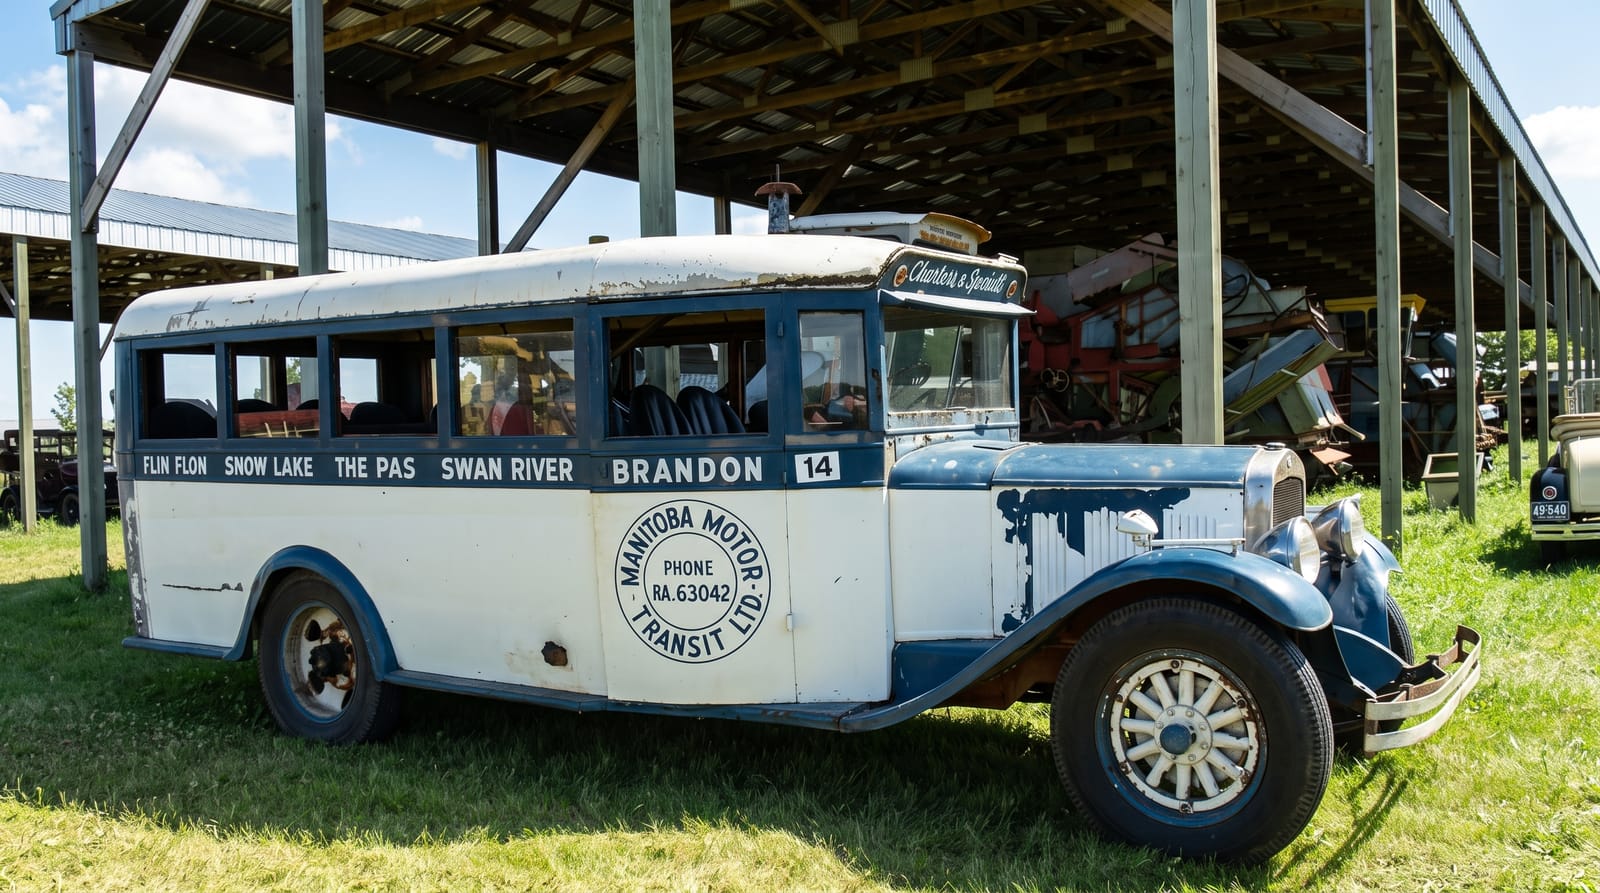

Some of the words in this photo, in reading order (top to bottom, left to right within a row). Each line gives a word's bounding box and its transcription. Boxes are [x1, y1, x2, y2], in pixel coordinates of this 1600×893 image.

[957, 272, 967, 288] &
[143, 455, 170, 475] FLIN
[175, 455, 207, 476] FLON
[224, 455, 268, 477] SNOW
[273, 456, 314, 478] LAKE
[335, 456, 368, 479] THE
[376, 456, 416, 480] PAS
[441, 456, 502, 481] SWAN
[511, 457, 574, 482] RIVER
[612, 456, 763, 484] BRANDON
[803, 455, 833, 479] 14
[620, 505, 694, 586] MANITOBA
[701, 509, 764, 582] MOTOR
[663, 560, 714, 576] PHONE
[652, 584, 730, 602] RA.63042
[631, 604, 725, 658] TRANSIT
[728, 593, 763, 635] LTD.
